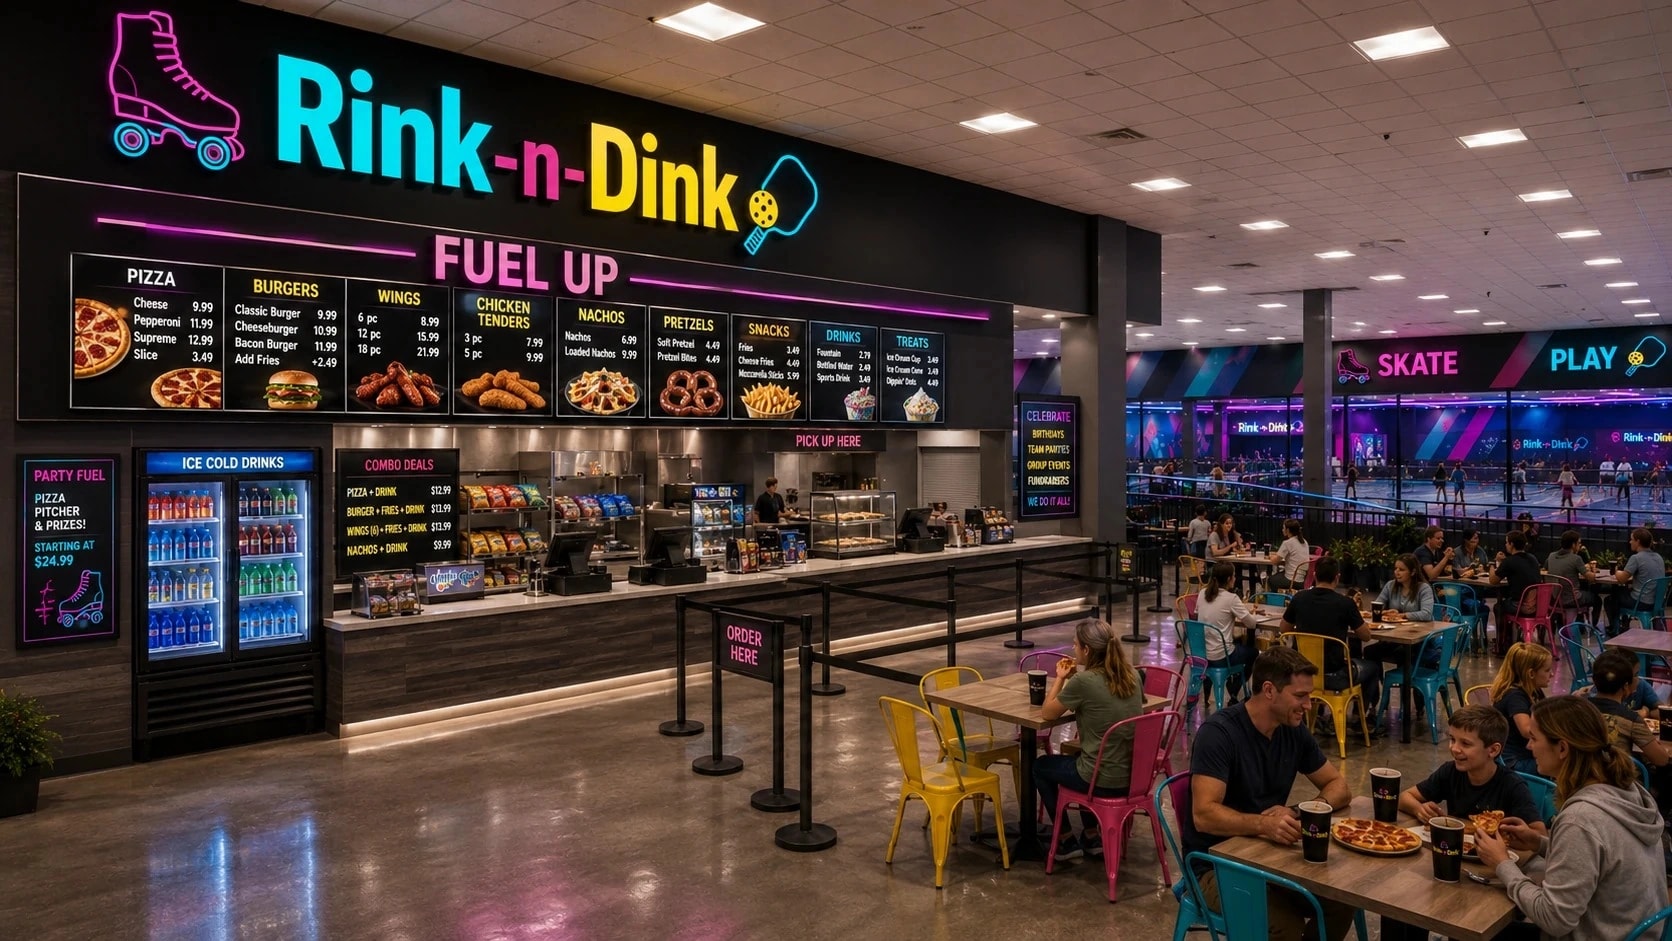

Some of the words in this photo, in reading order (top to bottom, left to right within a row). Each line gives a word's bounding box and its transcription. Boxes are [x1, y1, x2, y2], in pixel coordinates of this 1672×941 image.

[277, 53, 740, 233] Rink-n-Dink
[435, 234, 549, 290] FUEL
[564, 250, 619, 296] UP
[127, 268, 176, 287] PIZZA
[253, 278, 319, 298] BURGERS
[378, 289, 421, 306] WINGS
[134, 297, 168, 310] Cheese
[193, 301, 213, 313] 9.99
[235, 304, 268, 317] Classic
[270, 307, 301, 320] Burger
[317, 310, 337, 320] 9.99
[476, 297, 530, 315] CHICKEN
[134, 314, 181, 328] Pepperoni
[190, 318, 213, 329] 11.99
[358, 313, 364, 323] 6
[367, 314, 378, 324] pc
[420, 316, 439, 328] 8.99
[478, 312, 530, 329] TENDERS
[578, 308, 625, 324] NACHOS
[664, 315, 714, 331] PRETZELS
[235, 320, 298, 335] Cheeseburger
[313, 325, 337, 336] 10.99
[358, 328, 368, 339] 12
[370, 330, 381, 340] pc
[417, 332, 439, 342] 15.99
[748, 323, 790, 337] SNACKS
[134, 331, 177, 345] Supreme
[188, 334, 213, 346] 12.99
[464, 333, 470, 343] 3
[472, 335, 482, 344] pc
[526, 337, 543, 348] 7.99
[565, 331, 591, 342] Nachos
[621, 335, 637, 345] 6.99
[826, 329, 861, 343] DRINKS
[896, 335, 929, 348] TREATS
[235, 337, 264, 349] Bacon
[266, 339, 298, 352] Burger
[315, 341, 337, 352] 11.99
[657, 337, 671, 347] Soft
[672, 338, 695, 348] Pretzel
[705, 341, 720, 350] 4.49
[738, 342, 753, 352] Fries
[134, 349, 158, 360] Slice
[192, 351, 213, 363] 3.49
[358, 344, 368, 354] 18
[370, 345, 381, 356] pc
[417, 347, 439, 358] 21.99
[464, 349, 470, 358] 5
[472, 350, 482, 360] pc
[526, 352, 543, 363] 9.99
[565, 346, 590, 357] Loaded
[592, 347, 616, 359] Nachos
[622, 350, 637, 360] 9.99
[816, 348, 841, 357] Fountain
[886, 353, 894, 361] Ice
[235, 353, 255, 364] Add
[257, 354, 280, 366] Fries
[311, 357, 337, 368] +2.49
[705, 355, 720, 363] 4.49
[738, 356, 759, 365] Cheese
[760, 357, 774, 366] Fries
[1378, 350, 1458, 377] SKATE
[1551, 346, 1617, 371] PLAY
[787, 372, 800, 380] 5.99
[886, 365, 894, 373] Ice
[816, 373, 835, 383] Sports
[835, 373, 850, 382] Drink
[1027, 411, 1071, 422] CELEBRATE
[795, 434, 819, 448] PICK
[821, 434, 835, 447] UP
[837, 434, 861, 447] HERE
[1032, 429, 1064, 439] BIRTHDAYS
[1028, 445, 1044, 454] TEAM
[182, 457, 202, 470] ICE
[206, 456, 238, 469] COLD
[242, 456, 284, 468] DRINKS
[365, 459, 401, 471] COMBO
[404, 459, 434, 470] DEALS
[1027, 461, 1047, 470] GROUP
[1048, 461, 1070, 470] EVENTS
[35, 469, 73, 482] PARTY
[77, 469, 105, 481] FUEL
[35, 493, 65, 504] PIZZA
[347, 488, 367, 497] PIZZA
[375, 486, 397, 497] DRINK
[431, 486, 451, 495] $12.99
[1027, 497, 1038, 507] WE
[1039, 497, 1048, 506] DO
[1050, 497, 1056, 505] IT
[1057, 496, 1070, 505] ALL!
[35, 506, 80, 518] PITCHER
[347, 507, 374, 517] BURGER
[381, 506, 399, 515] FRIES
[405, 504, 425, 514] DRINK
[35, 521, 43, 531] &
[46, 519, 86, 530] PRIZES!
[347, 526, 369, 536] WINGS
[370, 525, 379, 537] (6)
[385, 524, 402, 534] FRIES
[408, 523, 427, 533] DRINK
[35, 541, 80, 552] STARTING
[83, 540, 95, 550] AT
[347, 545, 378, 556] NACHOS
[386, 542, 408, 553] DRINK
[434, 540, 451, 550] $9.99
[35, 555, 74, 569] $24.99
[727, 625, 762, 647] ORDER
[731, 645, 758, 666] HERE
